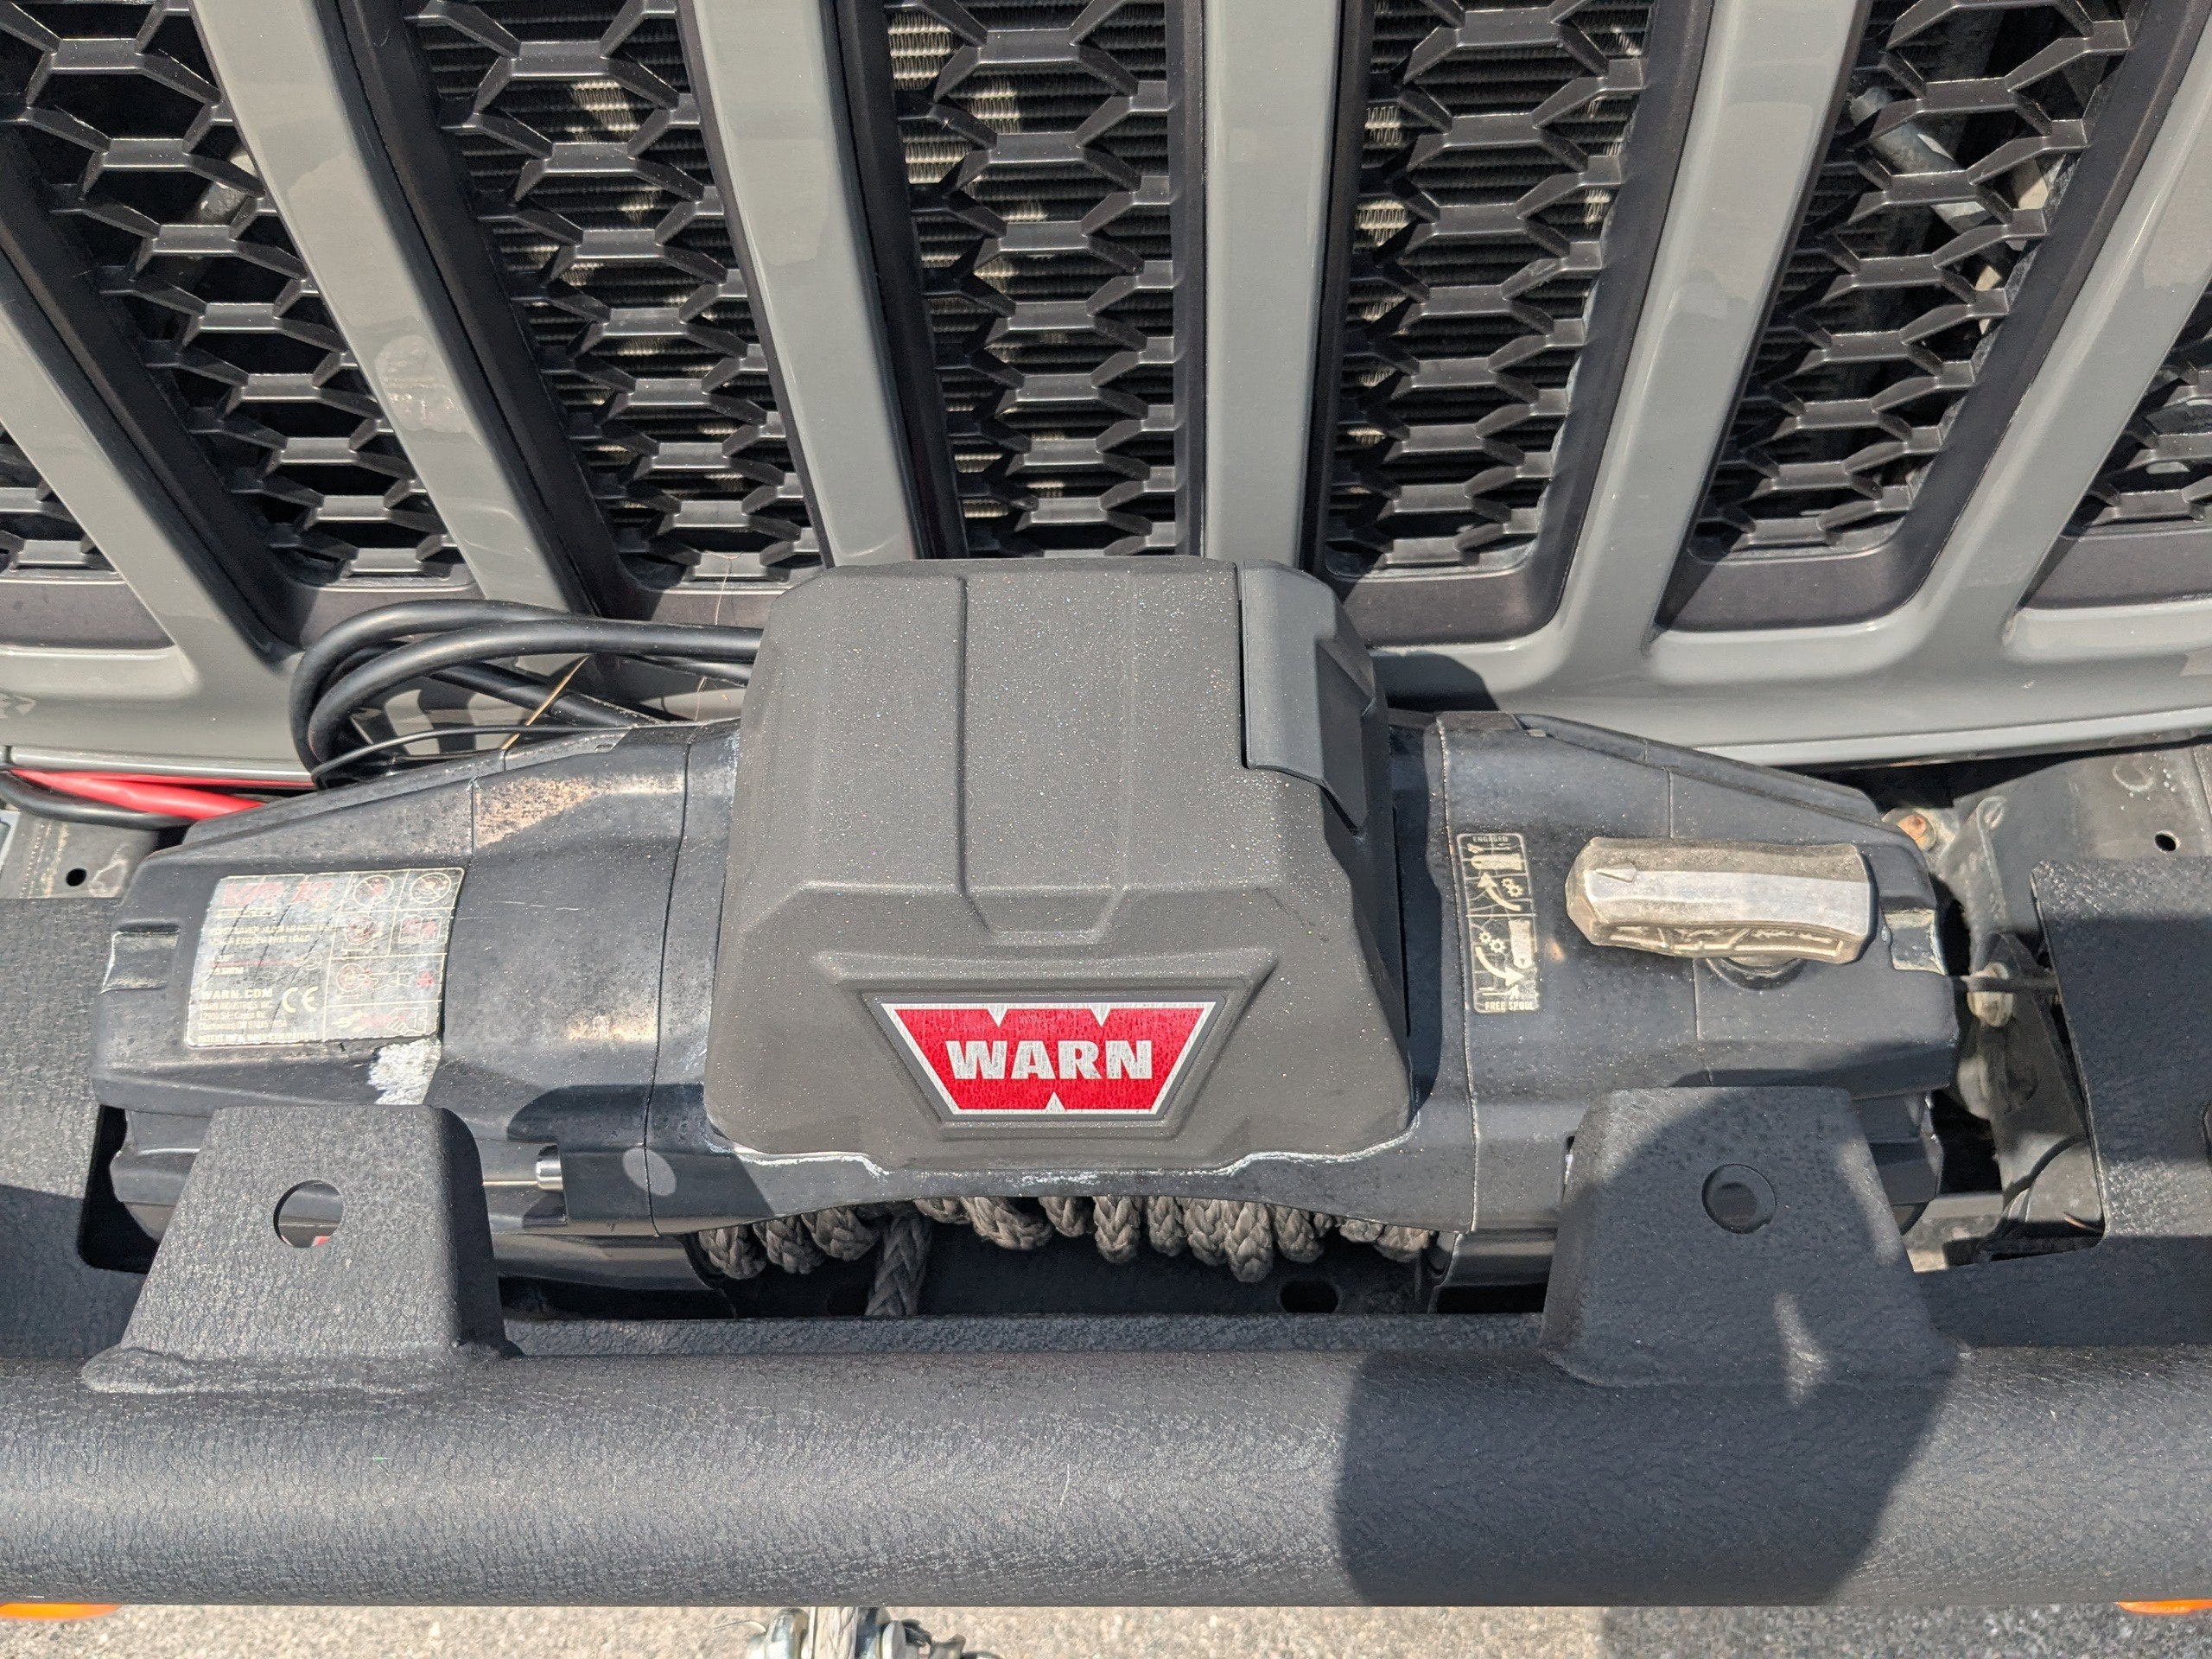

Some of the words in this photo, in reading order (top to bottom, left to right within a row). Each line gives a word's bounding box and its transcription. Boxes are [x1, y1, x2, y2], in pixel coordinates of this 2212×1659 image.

[201, 988, 273, 1000] WARN.COM
[1484, 1001, 1506, 1012] FREE
[1508, 1001, 1535, 1012] SPOOL
[945, 1039, 1153, 1080] WARN
